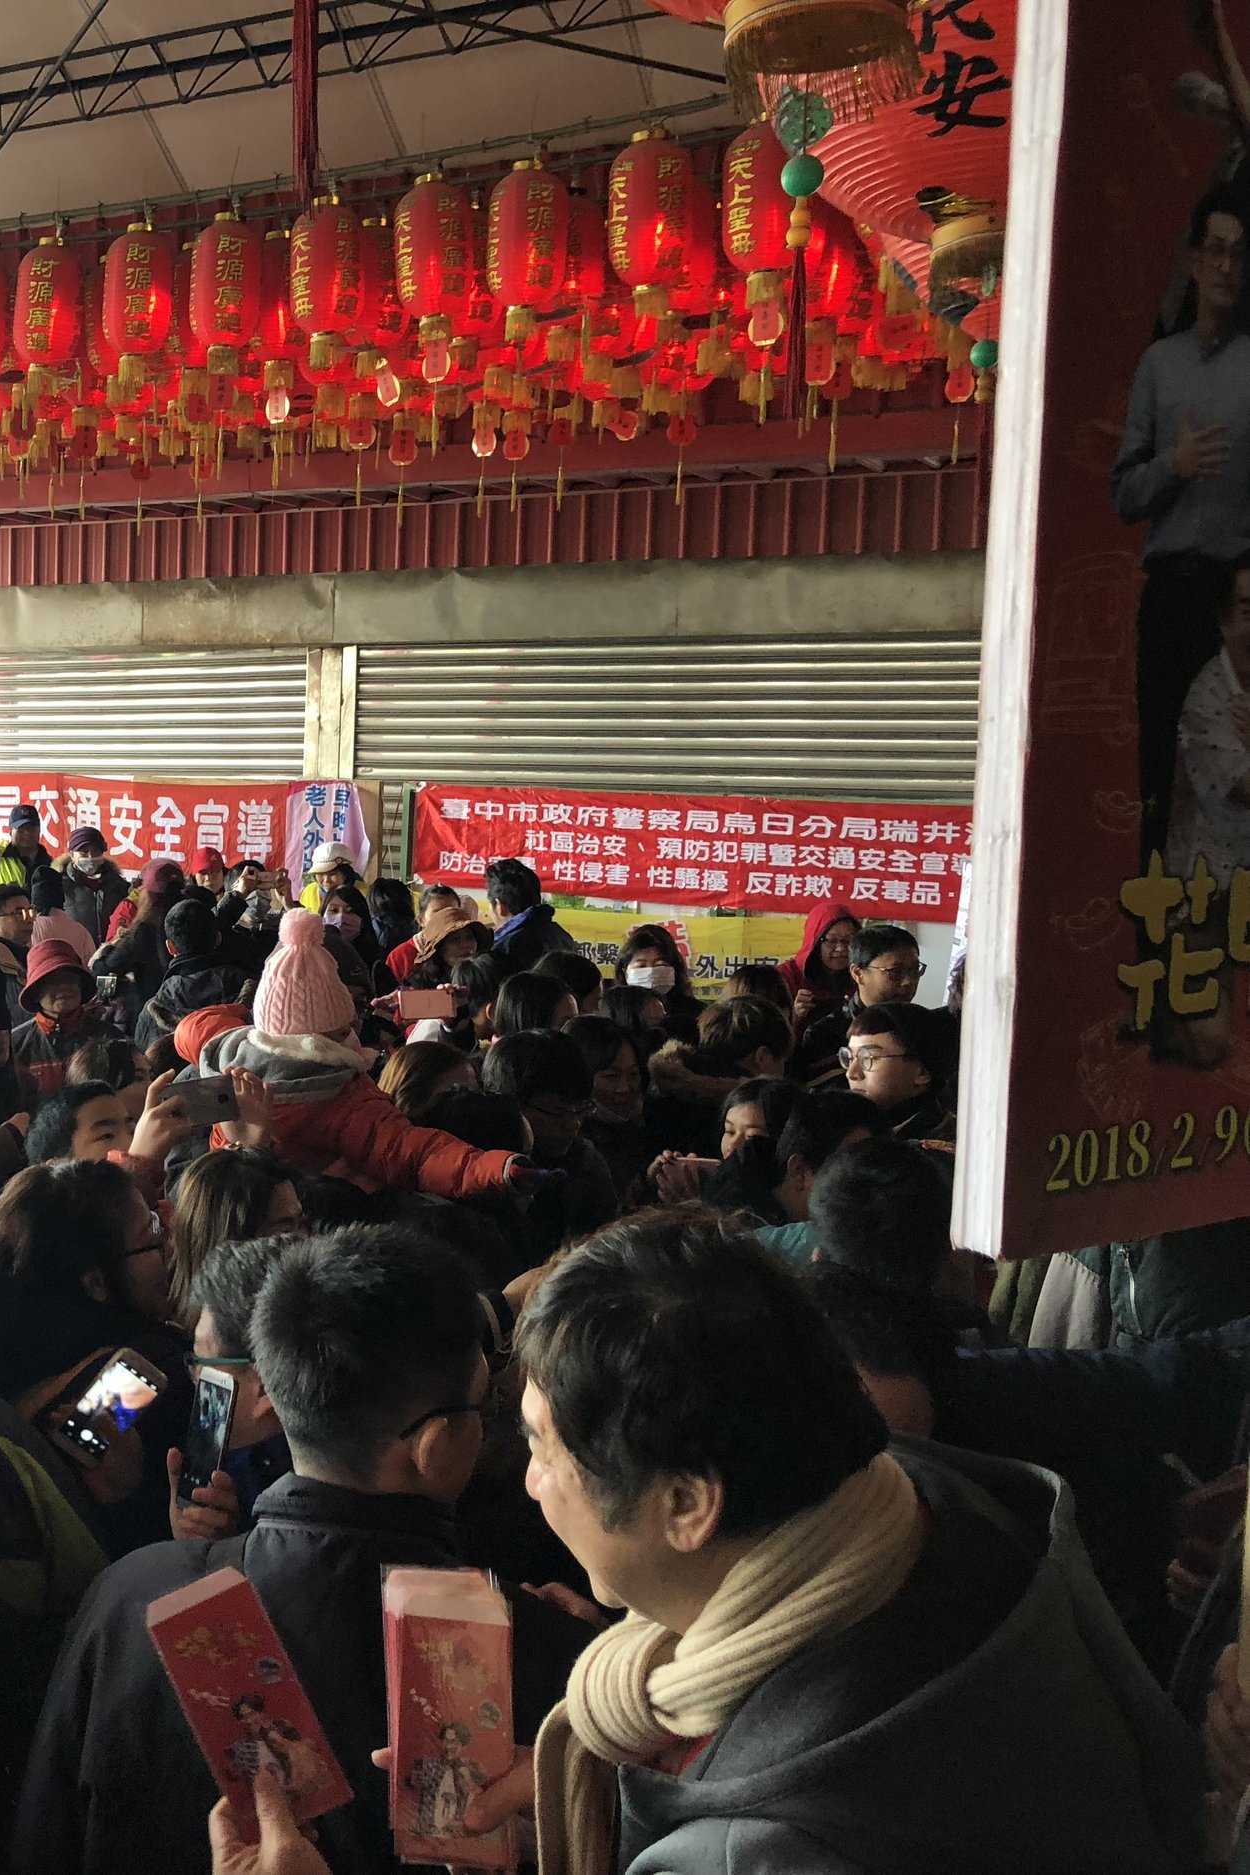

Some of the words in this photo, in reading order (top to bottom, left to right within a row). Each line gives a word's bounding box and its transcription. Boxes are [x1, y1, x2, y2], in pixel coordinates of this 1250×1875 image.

[609, 176, 631, 272] 天上聖母
[727, 156, 756, 255] 天上聖母
[26, 257, 60, 352] 財源廣進
[124, 243, 156, 338] 財源廣進
[214, 234, 247, 333] 財源廣進
[292, 232, 315, 319] 天上聖母
[395, 211, 418, 303] 天上聖母
[440, 797, 972, 845] 臺中市政府警察局烏日分局瑞井
[1046, 1105, 1250, 1192] 2018/2/9
